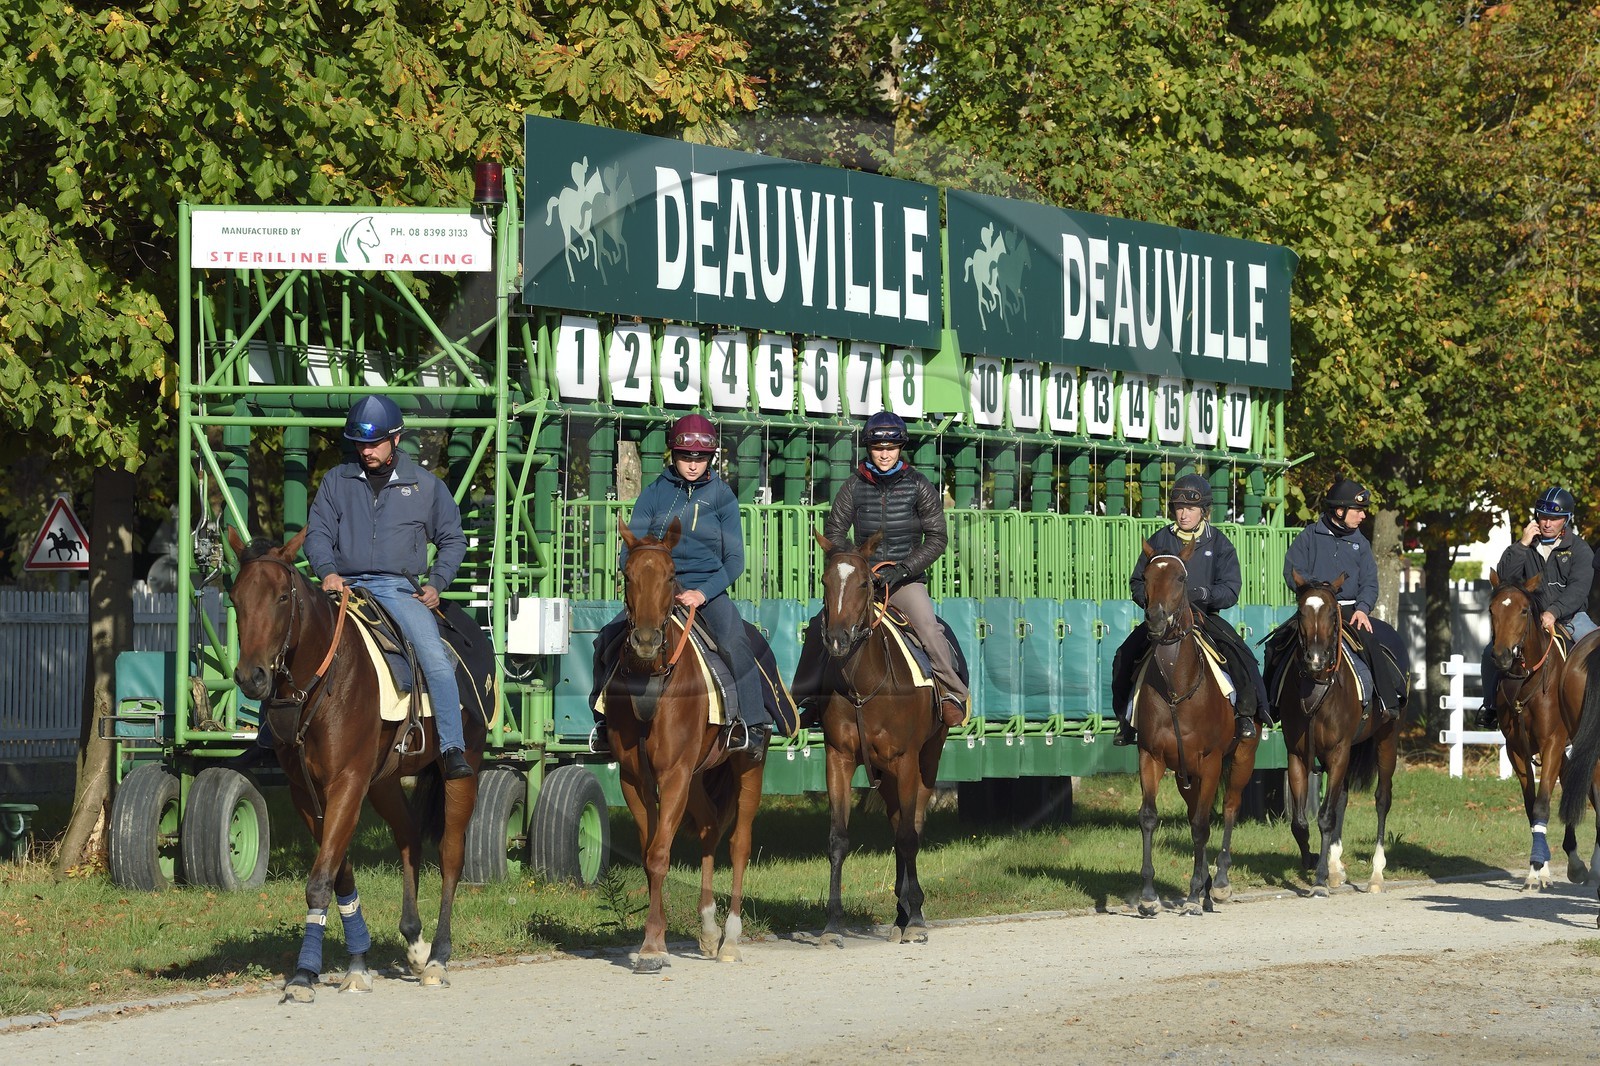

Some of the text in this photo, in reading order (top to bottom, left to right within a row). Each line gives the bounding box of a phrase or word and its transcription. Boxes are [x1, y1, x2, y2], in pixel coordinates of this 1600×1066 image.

[221, 226, 302, 236] MANUFACTURED BY
[390, 227, 468, 237] PH. 08 8398 3133
[655, 165, 930, 323] DEAUVILLE
[210, 251, 473, 264] STERILINE RACING
[1061, 233, 1268, 367] DEAUVILLE
[575, 328, 585, 385] 1
[624, 332, 640, 389] 2
[674, 336, 690, 392] 3
[722, 340, 738, 394] 4
[770, 344, 783, 397] 5
[815, 347, 829, 401] 6
[859, 351, 873, 403] 7
[902, 354, 916, 406] 8
[978, 363, 998, 413] 10
[1019, 368, 1034, 417] 11
[1054, 371, 1073, 420] 12
[1091, 375, 1110, 424] 13
[1127, 380, 1145, 427] 14
[1163, 384, 1180, 431] 15
[1196, 388, 1214, 434] 16
[1230, 391, 1247, 437] 17
